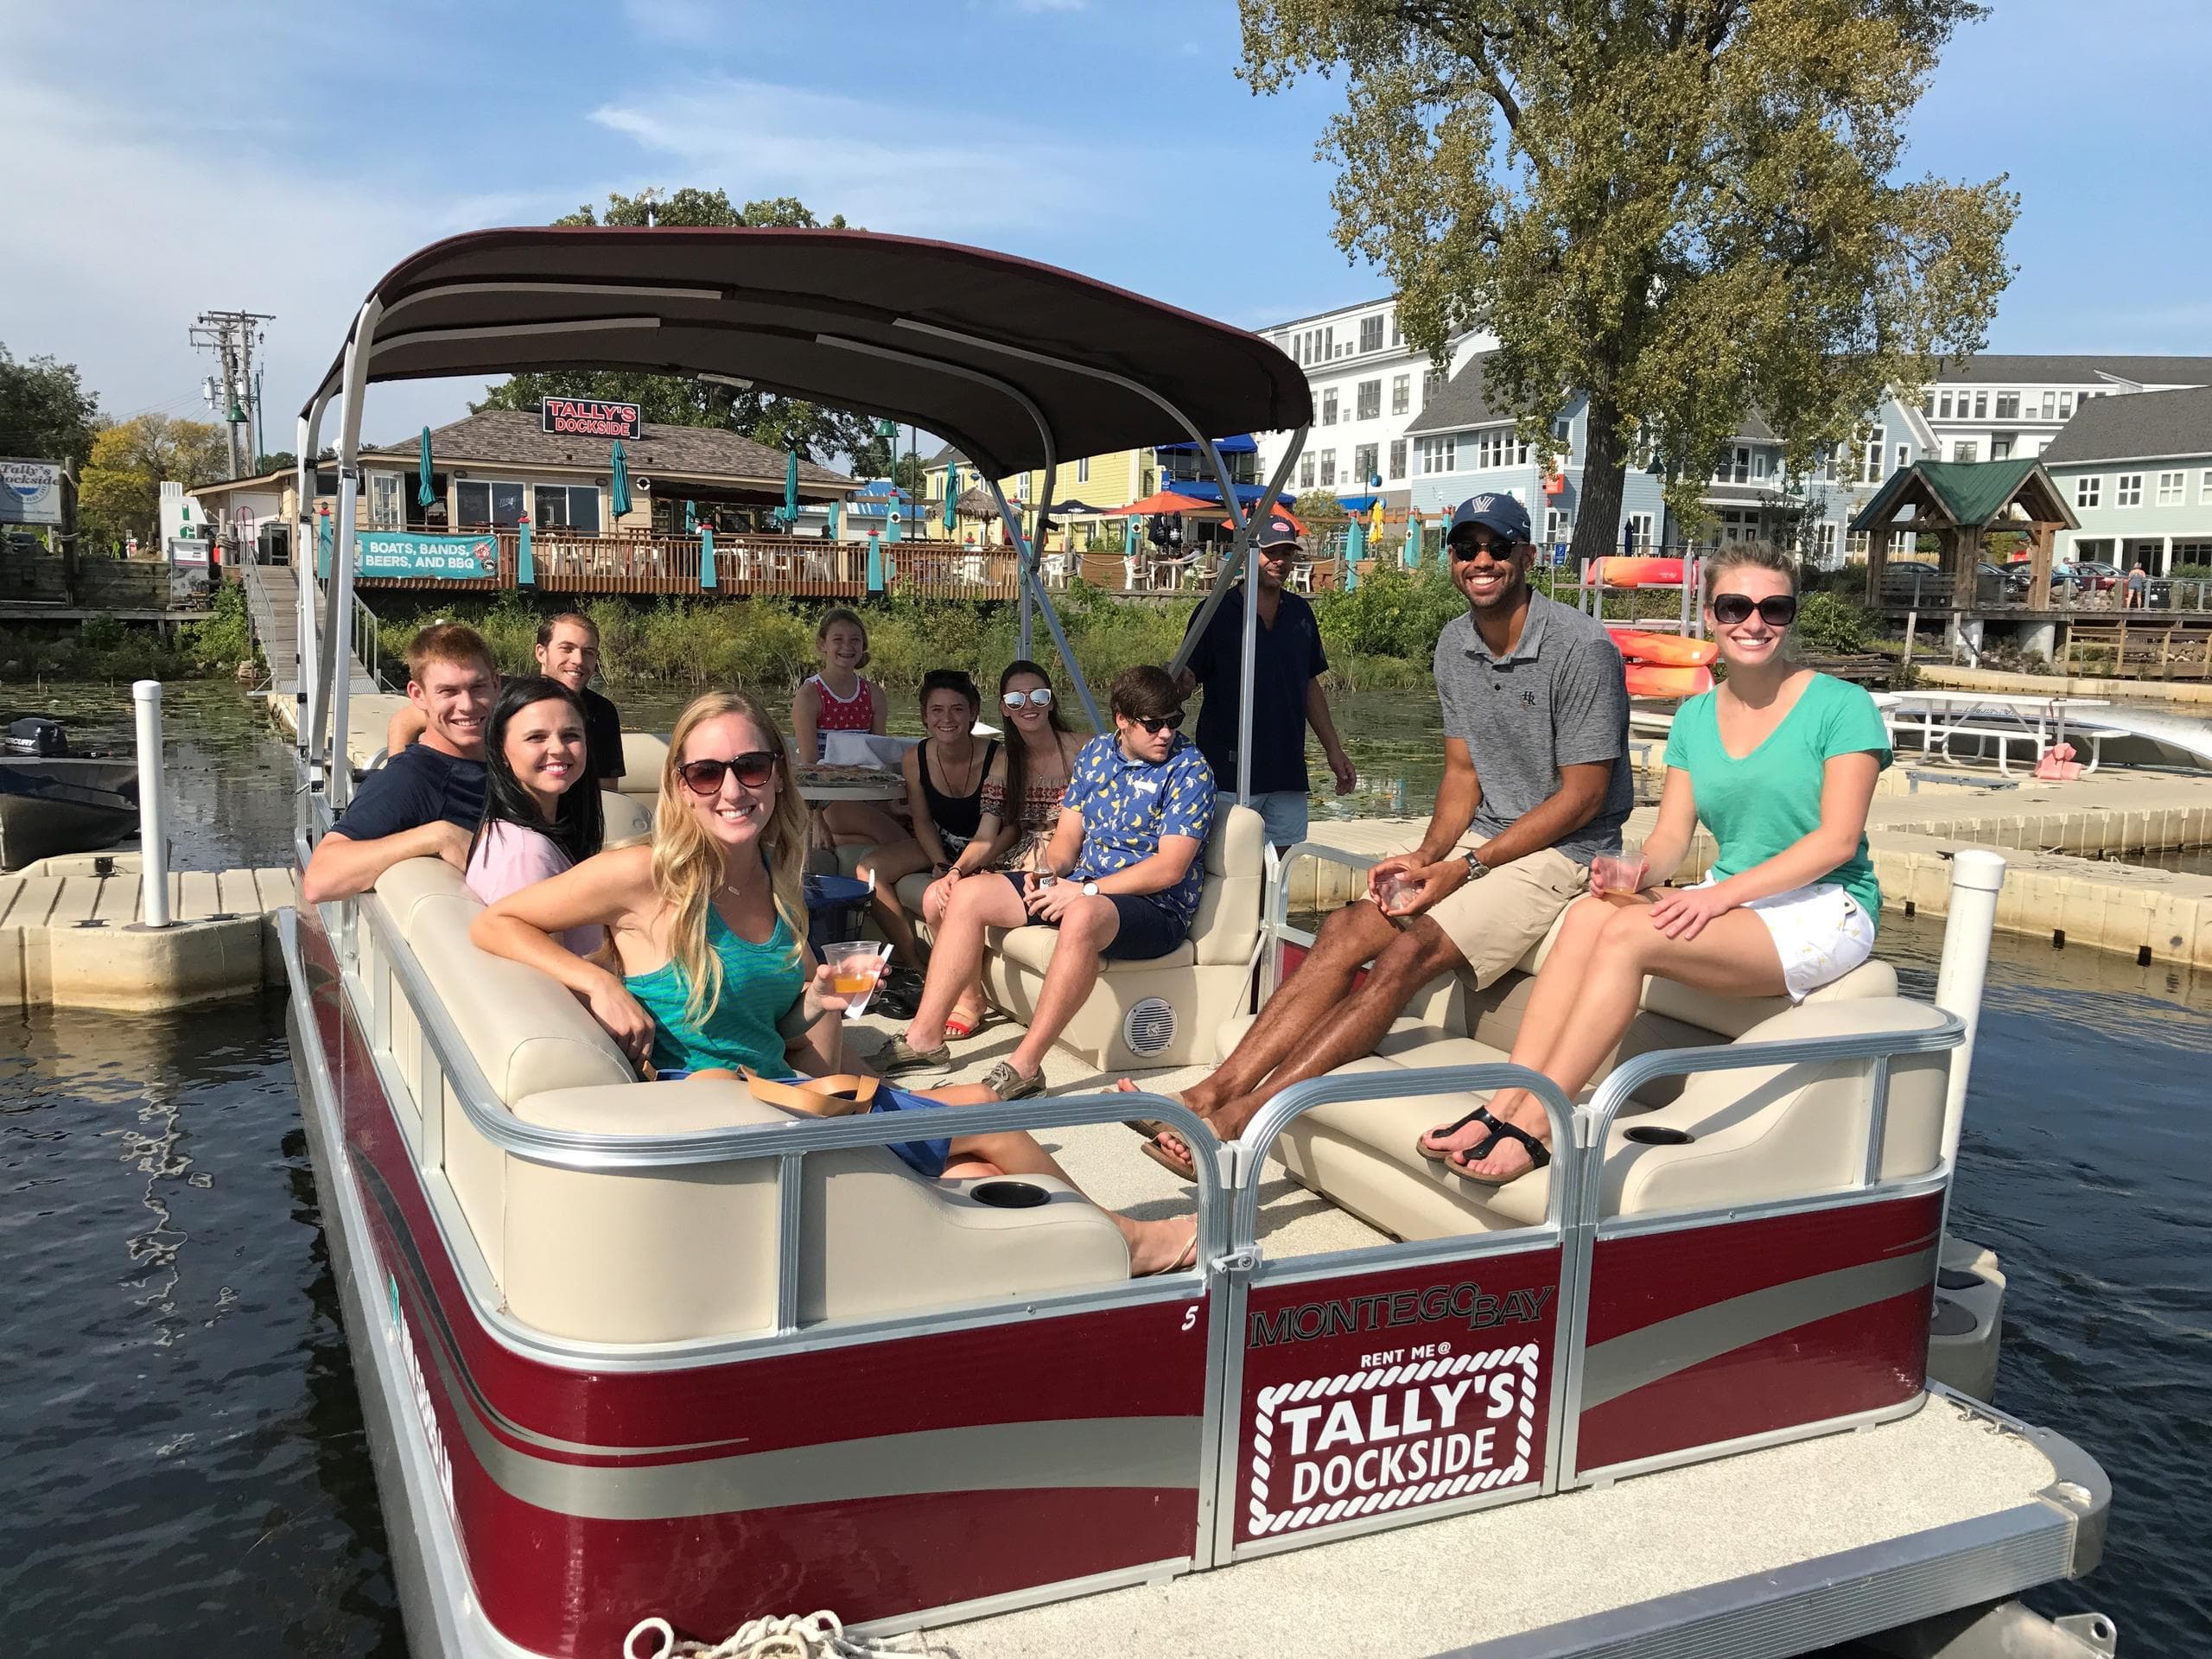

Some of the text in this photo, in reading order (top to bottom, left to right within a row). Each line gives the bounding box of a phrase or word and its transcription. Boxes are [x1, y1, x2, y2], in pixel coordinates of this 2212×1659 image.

[547, 401, 636, 422] TALLY'S
[556, 417, 630, 436] DOCKSIDE
[1, 464, 52, 476] Tally's
[370, 542, 470, 556] BOATS, BANDS,
[365, 555, 474, 569] BEERS, AND BBQ
[1181, 1306, 1199, 1331] 5
[1361, 1349, 1405, 1368] RENT
[1281, 1372, 1515, 1456] TALLY'S
[1292, 1427, 1496, 1504] DOCKSIDE
